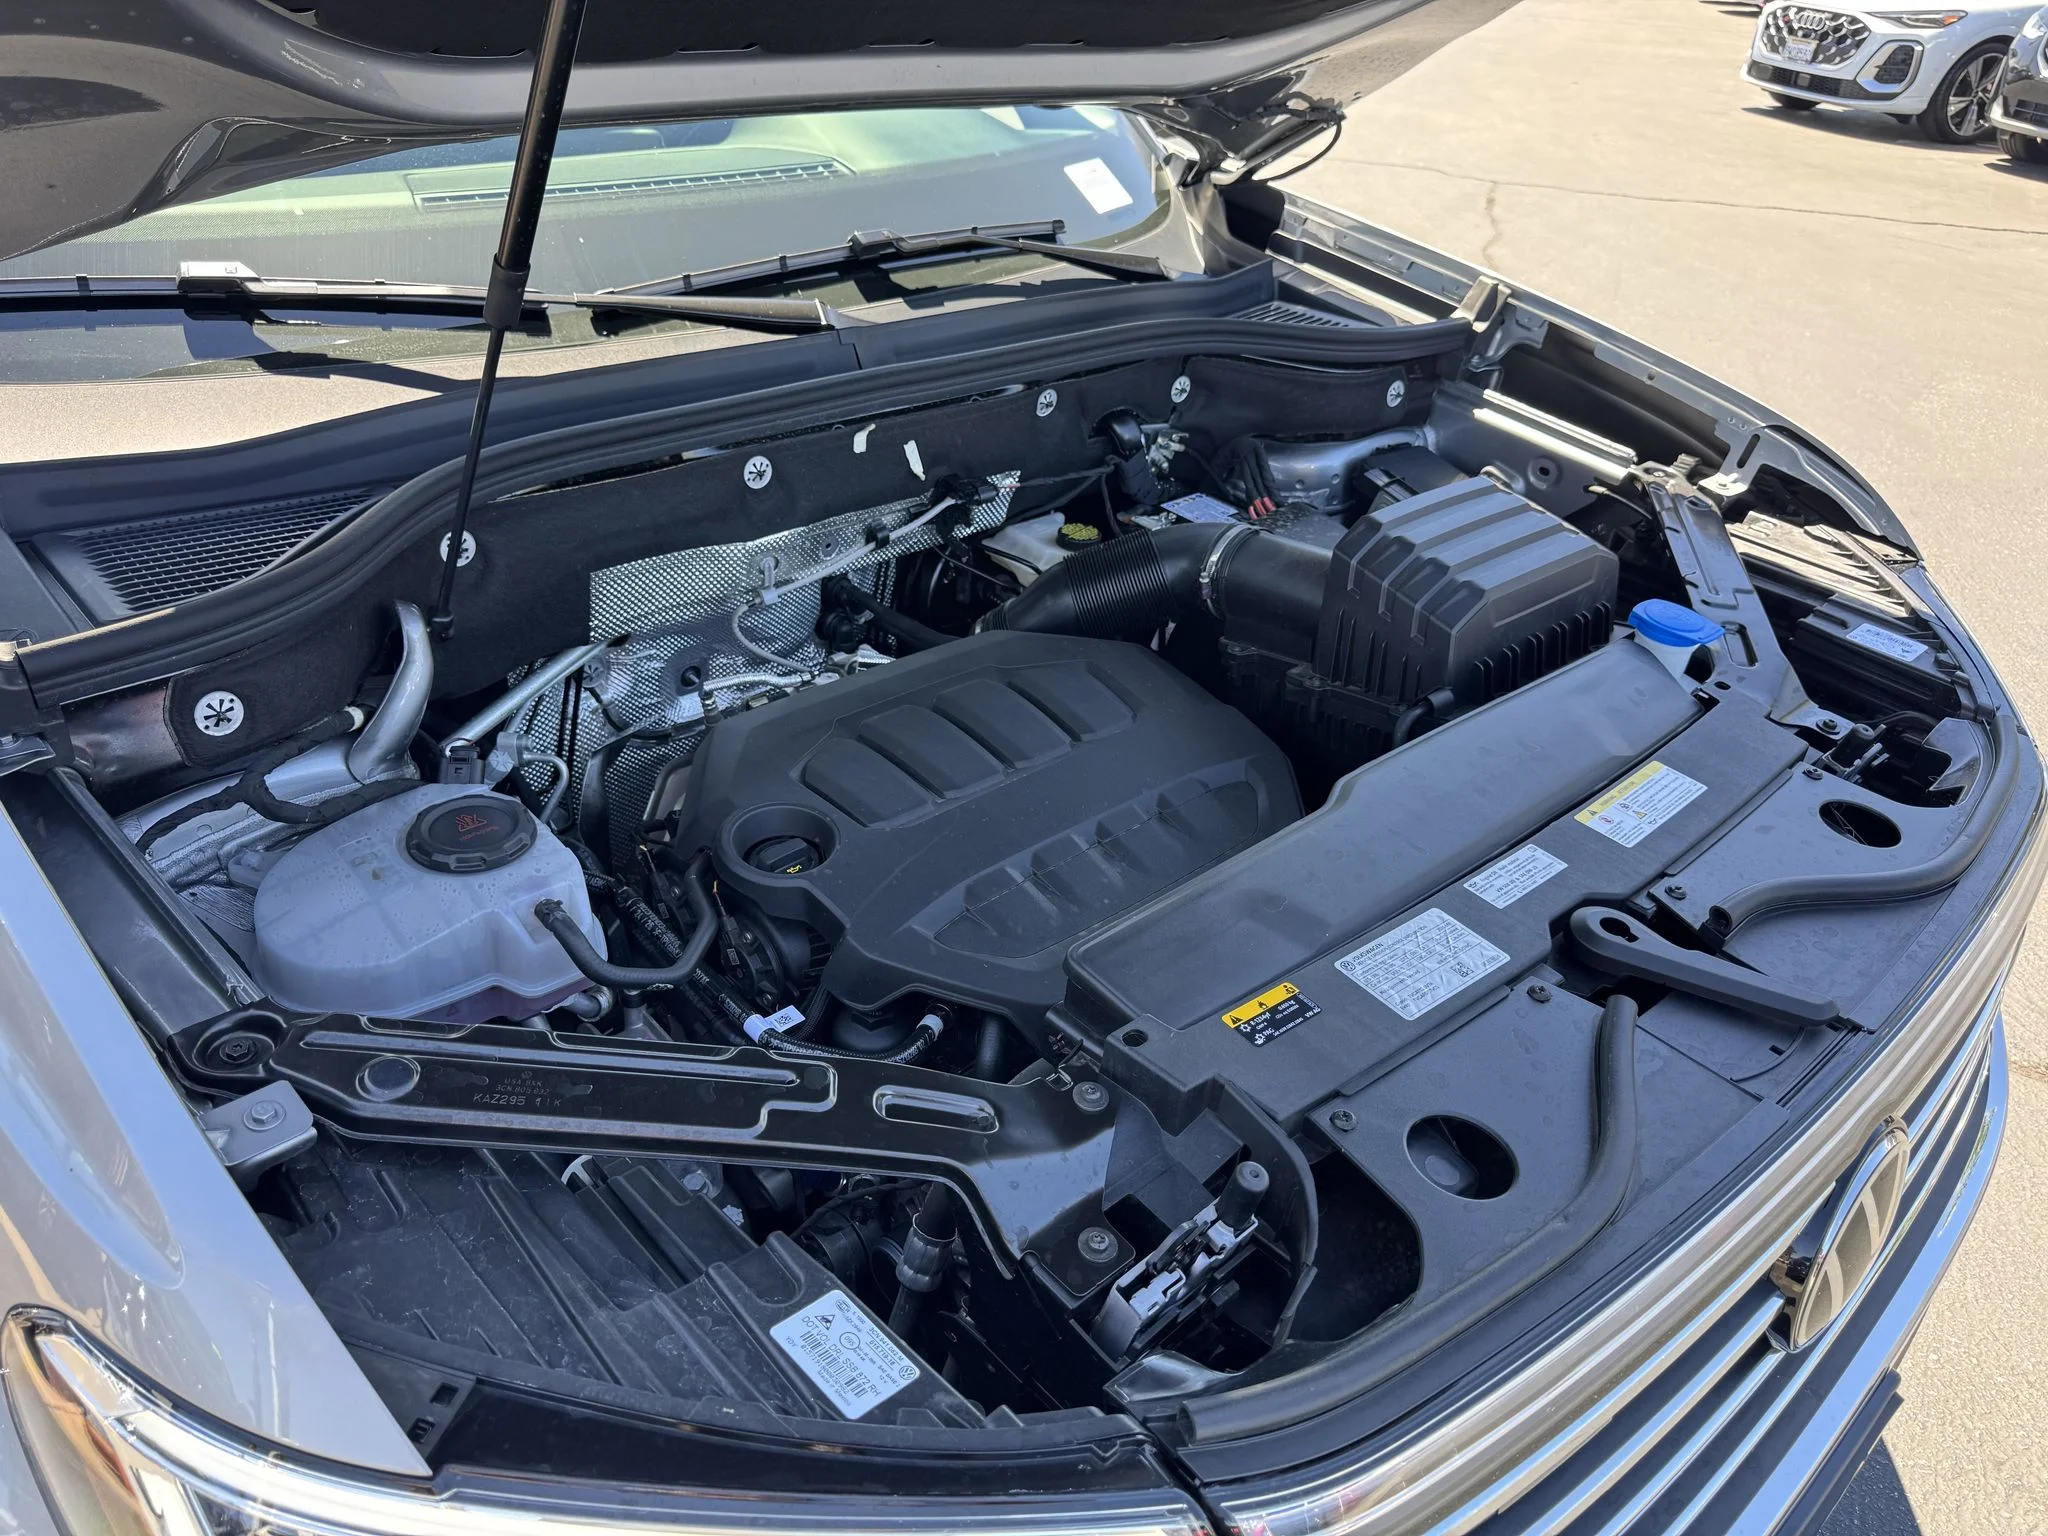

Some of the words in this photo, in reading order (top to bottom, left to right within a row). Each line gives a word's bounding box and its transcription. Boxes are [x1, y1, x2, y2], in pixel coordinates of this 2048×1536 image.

[472, 1092, 526, 1106] KAZ295
[800, 1315, 819, 1331] DOT
[815, 1330, 832, 1345] VOL
[828, 1343, 845, 1359] DRL
[841, 1357, 859, 1373] SSB
[867, 1384, 881, 1396] RH
